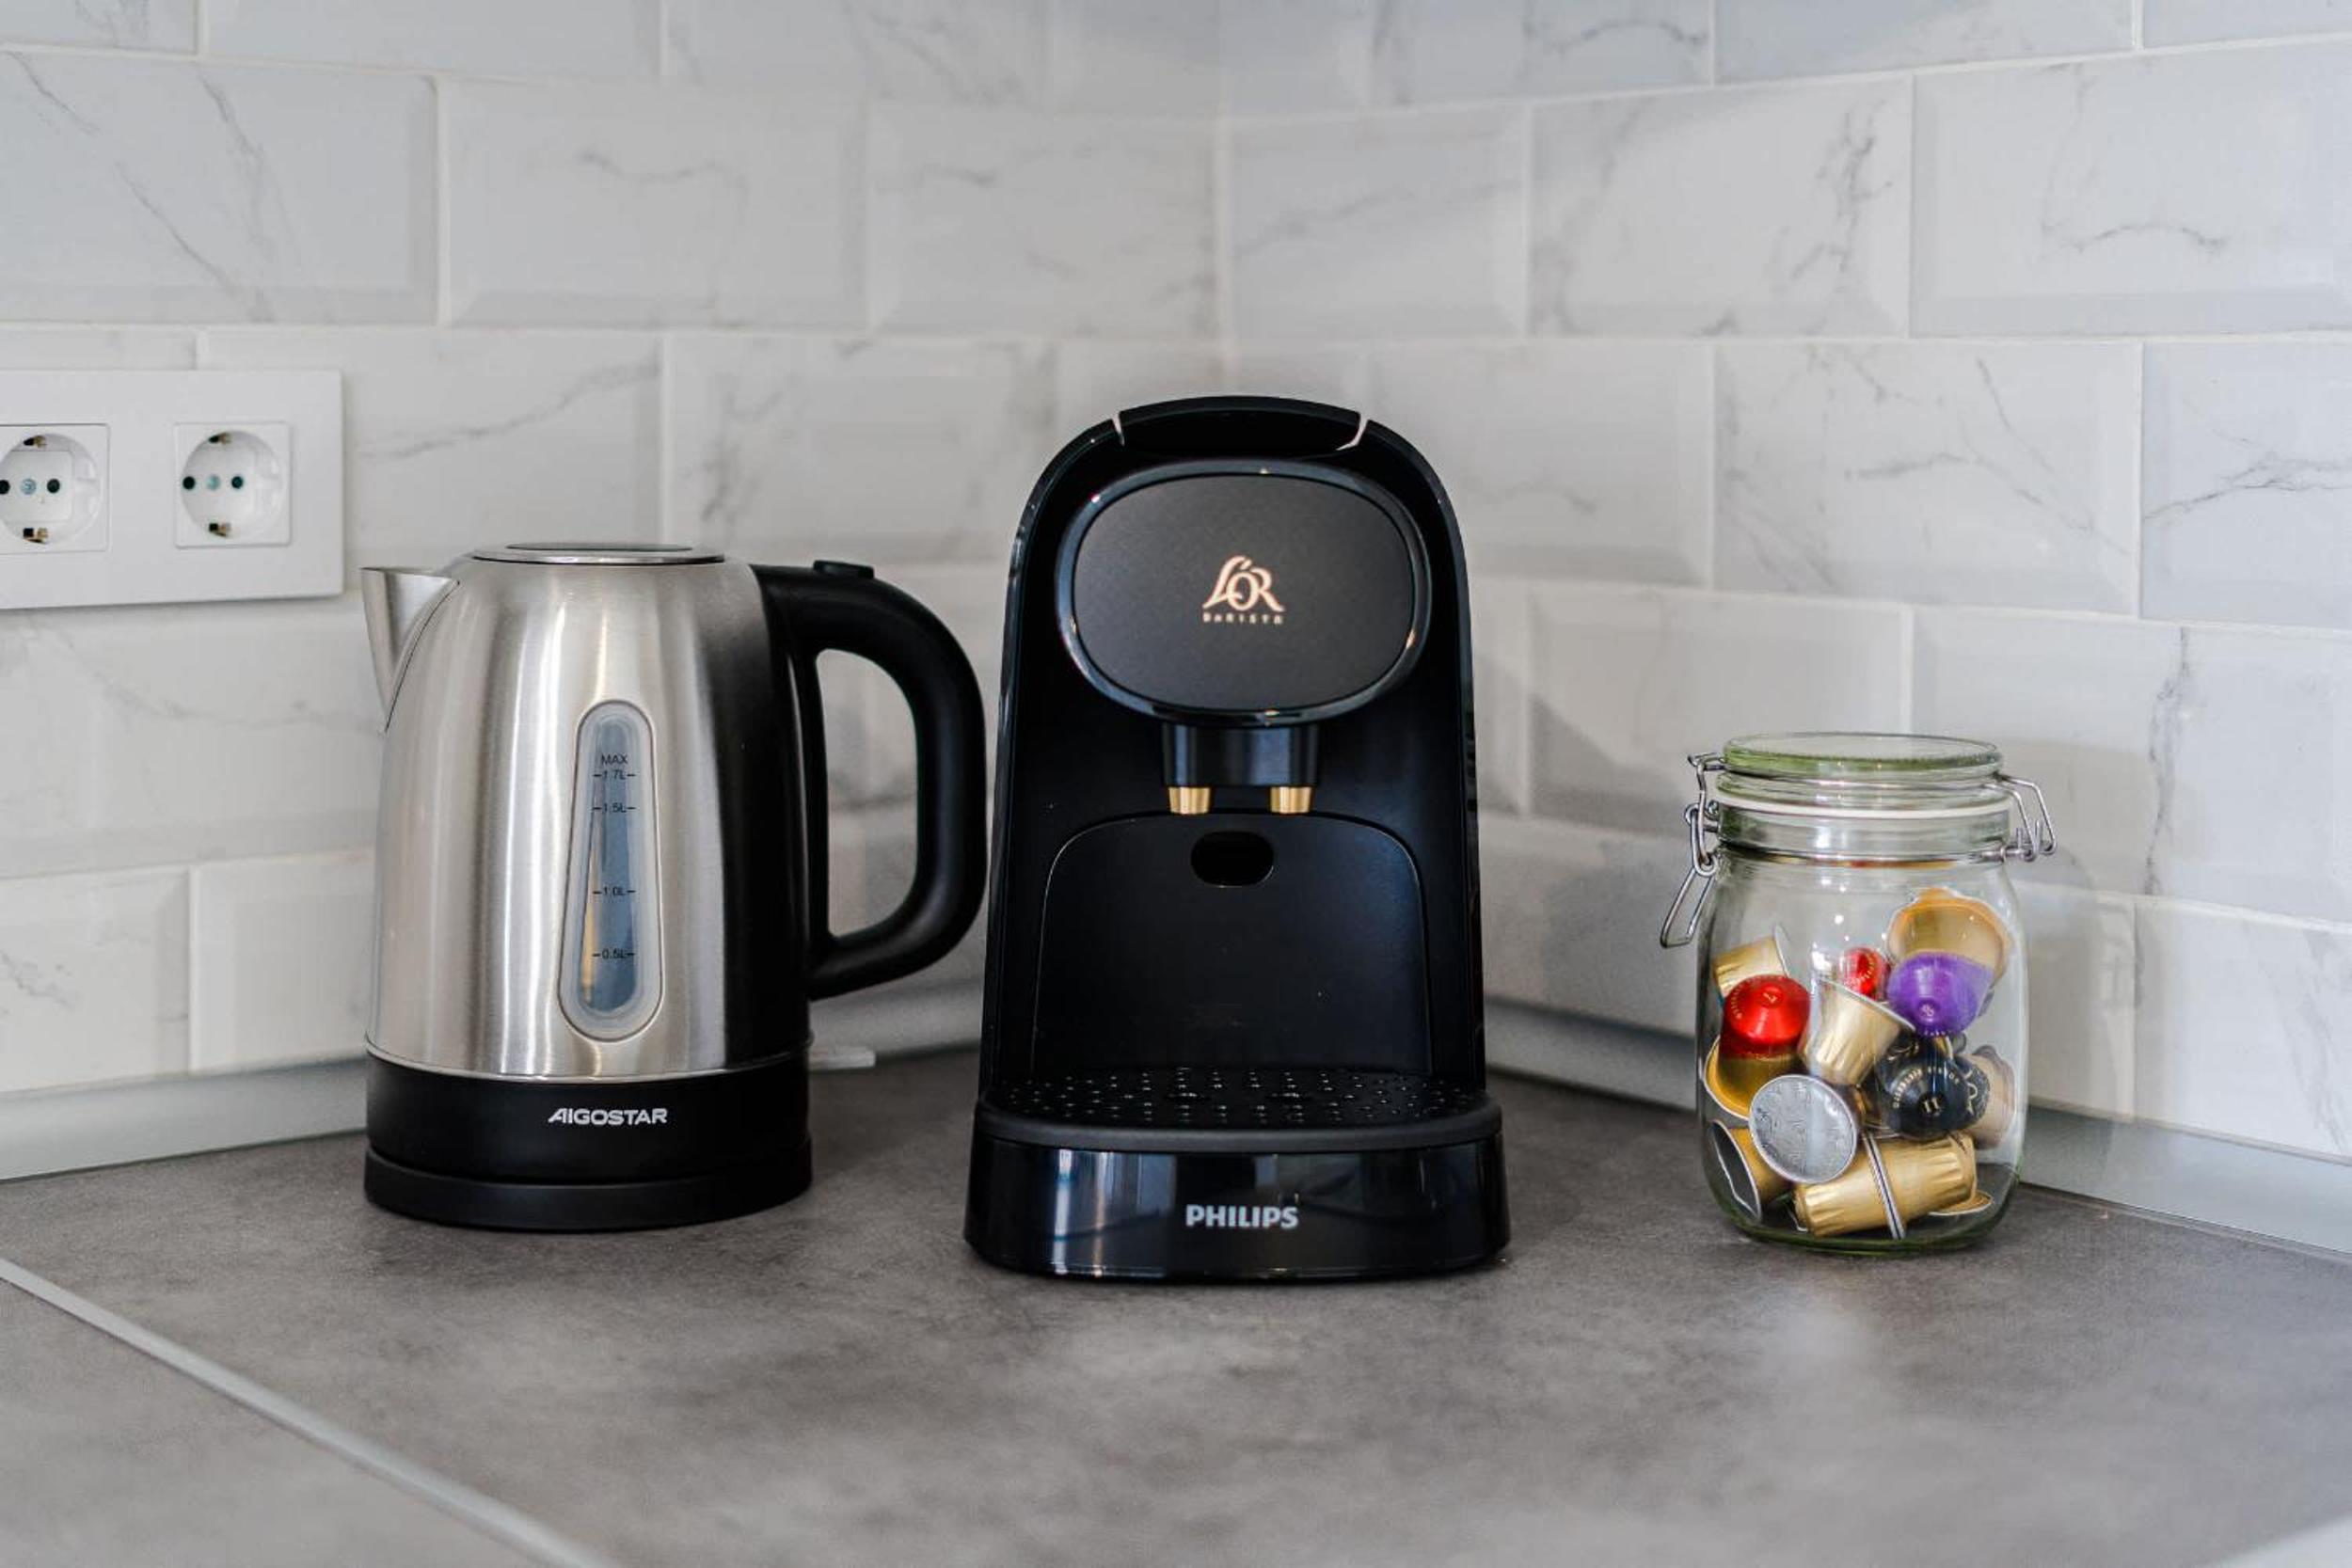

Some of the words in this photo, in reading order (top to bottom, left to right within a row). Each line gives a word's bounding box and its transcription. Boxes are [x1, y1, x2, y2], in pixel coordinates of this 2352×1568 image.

[601, 753, 628, 765] MAX
[602, 948, 628, 959] 0.5L
[548, 1108, 668, 1126] AIGOSTAR
[1185, 1204, 1299, 1229] PHILIPS
